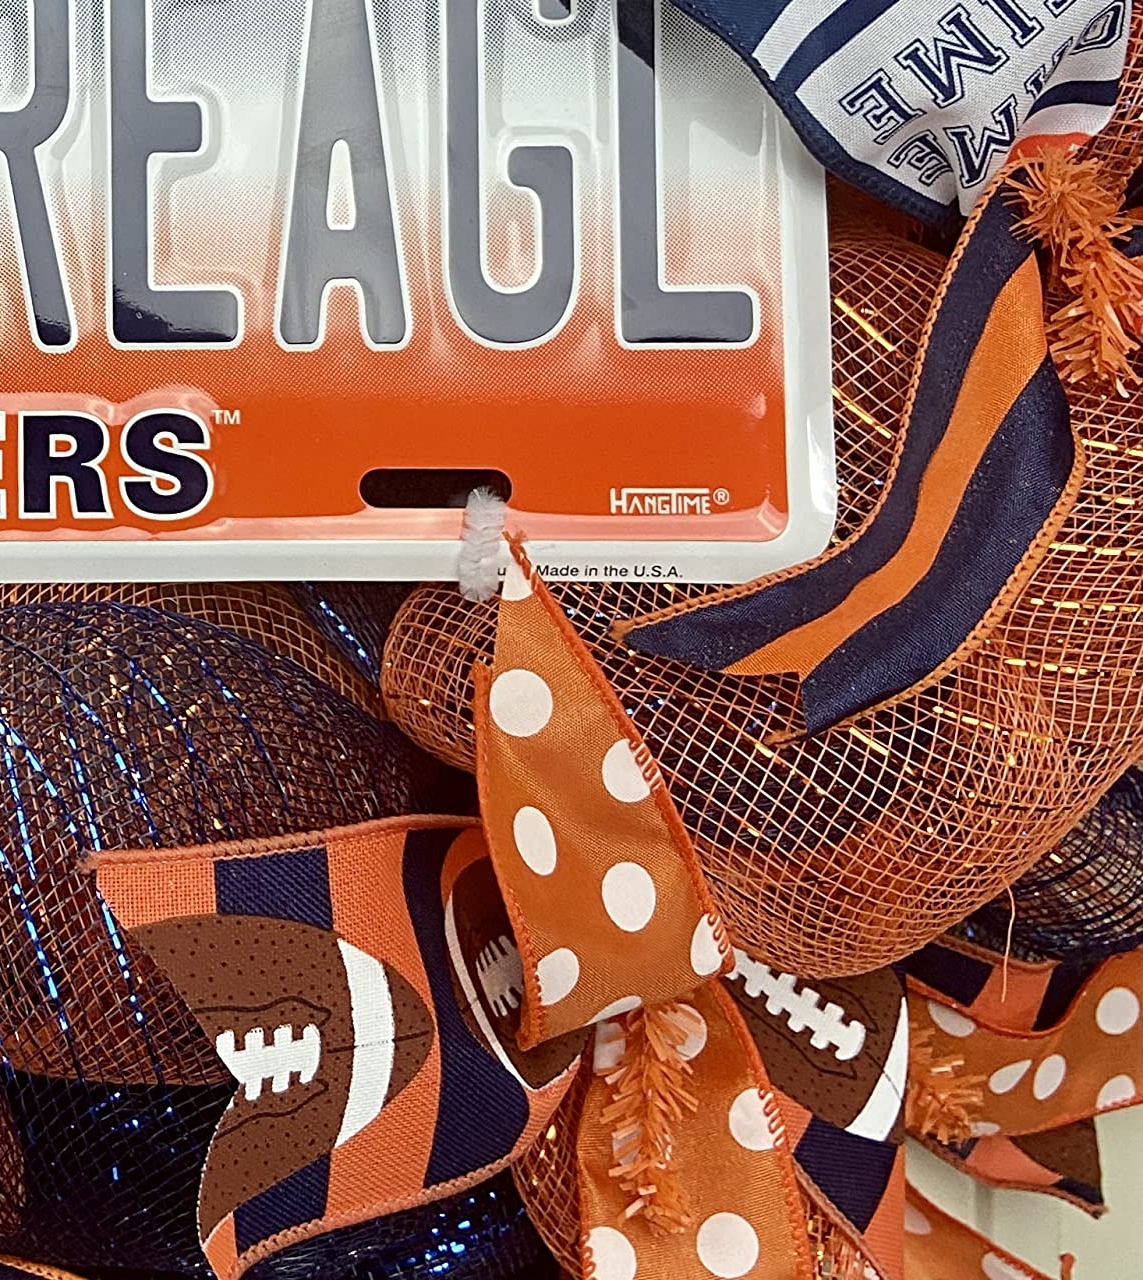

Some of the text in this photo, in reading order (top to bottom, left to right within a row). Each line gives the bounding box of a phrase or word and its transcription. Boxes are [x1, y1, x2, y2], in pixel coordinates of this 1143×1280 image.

[535, 563, 684, 579] Made in the U.S.A.
